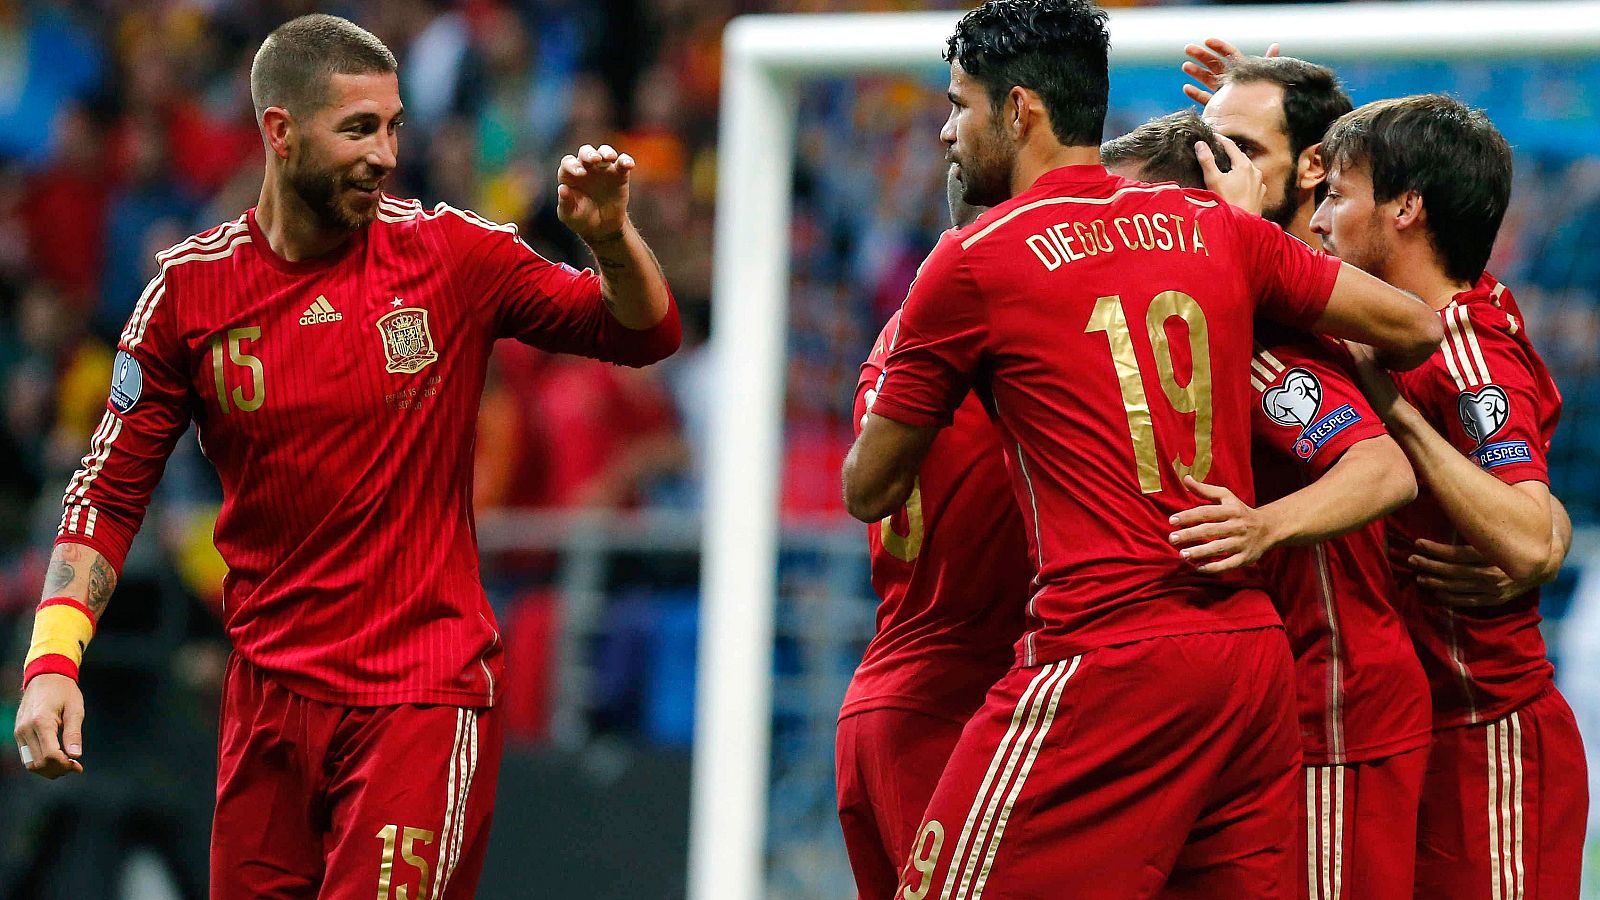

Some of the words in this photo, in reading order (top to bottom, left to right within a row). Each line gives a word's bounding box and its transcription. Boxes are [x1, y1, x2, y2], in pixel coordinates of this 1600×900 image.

[1025, 218, 1114, 272] DIEGO
[1113, 213, 1209, 257] COSTA
[299, 311, 343, 326] adidas
[212, 326, 265, 414] 15
[1084, 290, 1213, 494] 19
[1310, 407, 1357, 443] RESPECT
[1480, 446, 1529, 465] RESPECT
[375, 824, 434, 900] 15
